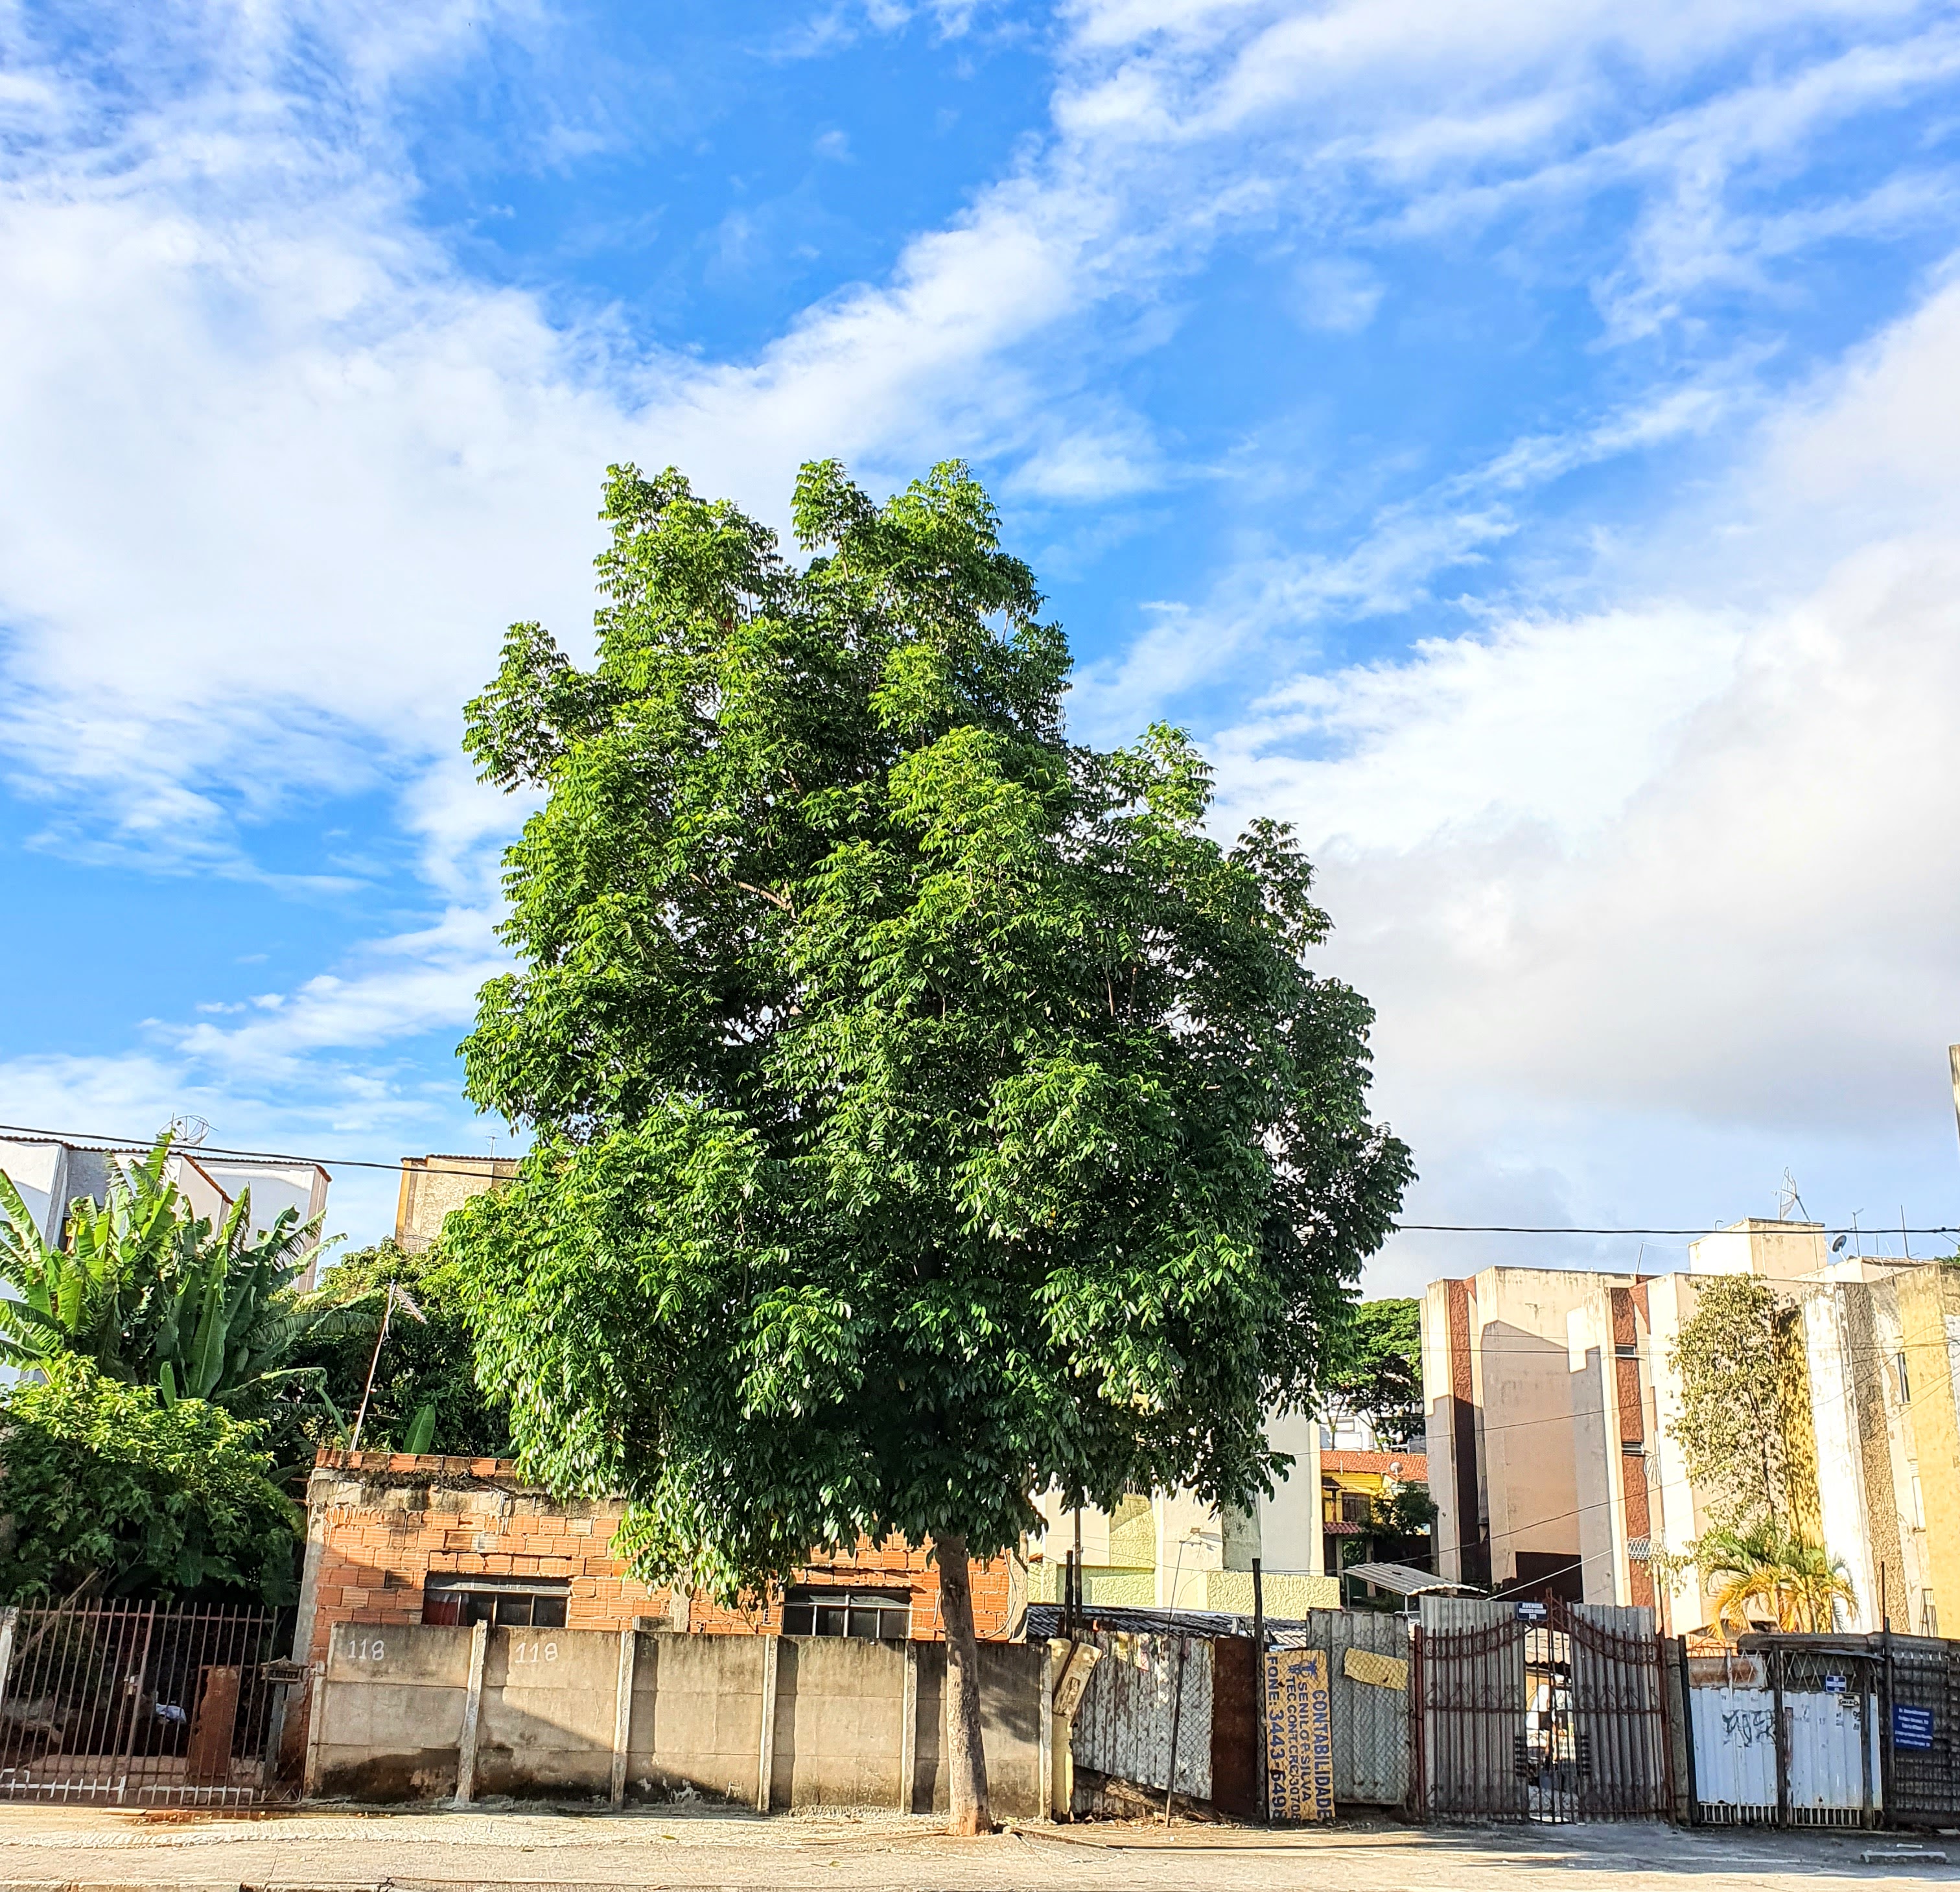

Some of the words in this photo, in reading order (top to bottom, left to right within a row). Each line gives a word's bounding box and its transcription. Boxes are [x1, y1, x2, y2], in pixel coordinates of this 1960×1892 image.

[348, 1639, 384, 1661] 118
[515, 1642, 558, 1663] 118
[1266, 1656, 1279, 1706] FONE:
[1298, 1682, 1309, 1740] SENILO
[1312, 1690, 1333, 1819] CONTABILIDADE
